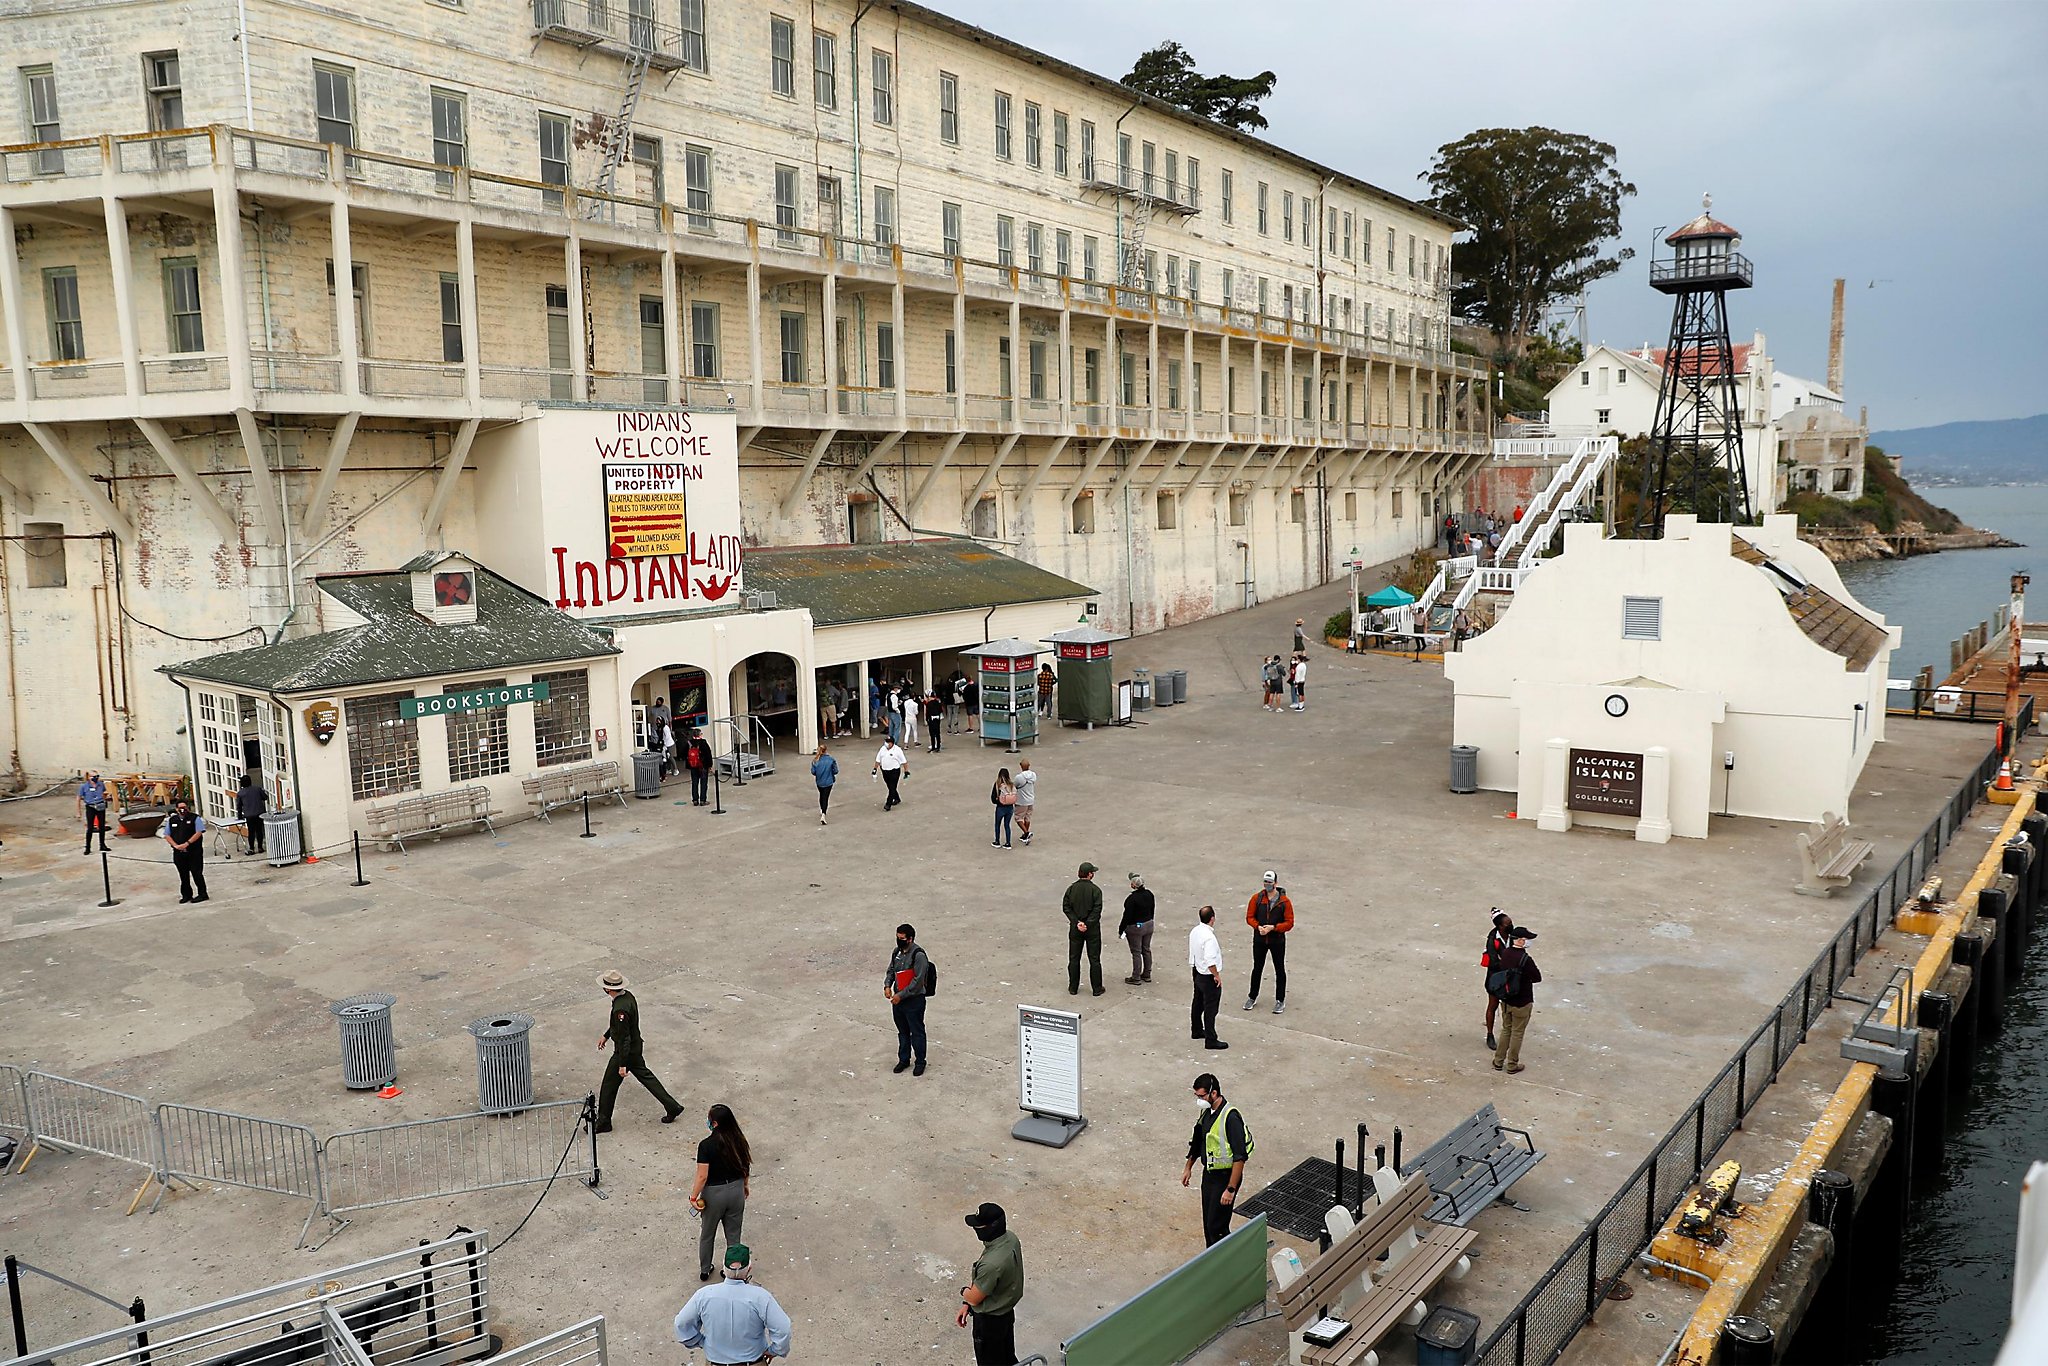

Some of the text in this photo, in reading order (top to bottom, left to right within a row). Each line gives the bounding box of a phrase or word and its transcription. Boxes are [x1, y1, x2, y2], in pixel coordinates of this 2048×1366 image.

[617, 412, 692, 434] INDIANS
[595, 436, 711, 459] WELCOME
[608, 464, 703, 480] UNITED INDIAN
[615, 480, 675, 490] PROPERTY
[609, 494, 633, 503] ALCATRAZ
[634, 494, 651, 502] ISLAND
[651, 494, 663, 502] AREA
[669, 493, 683, 501] ACRES
[639, 503, 666, 512] TRANSPORT
[667, 503, 681, 511] DOCK
[636, 532, 681, 542] ALLOWED ASHORE
[628, 544, 649, 552] WITHOUT
[656, 544, 670, 552] PASS
[416, 686, 536, 714] BOOKSTORE
[1576, 756, 1636, 769] ALCATRAZ
[1575, 766, 1636, 781] ISLAND
[1575, 793, 1609, 802] GOLDEN
[1612, 797, 1634, 805] GATE
